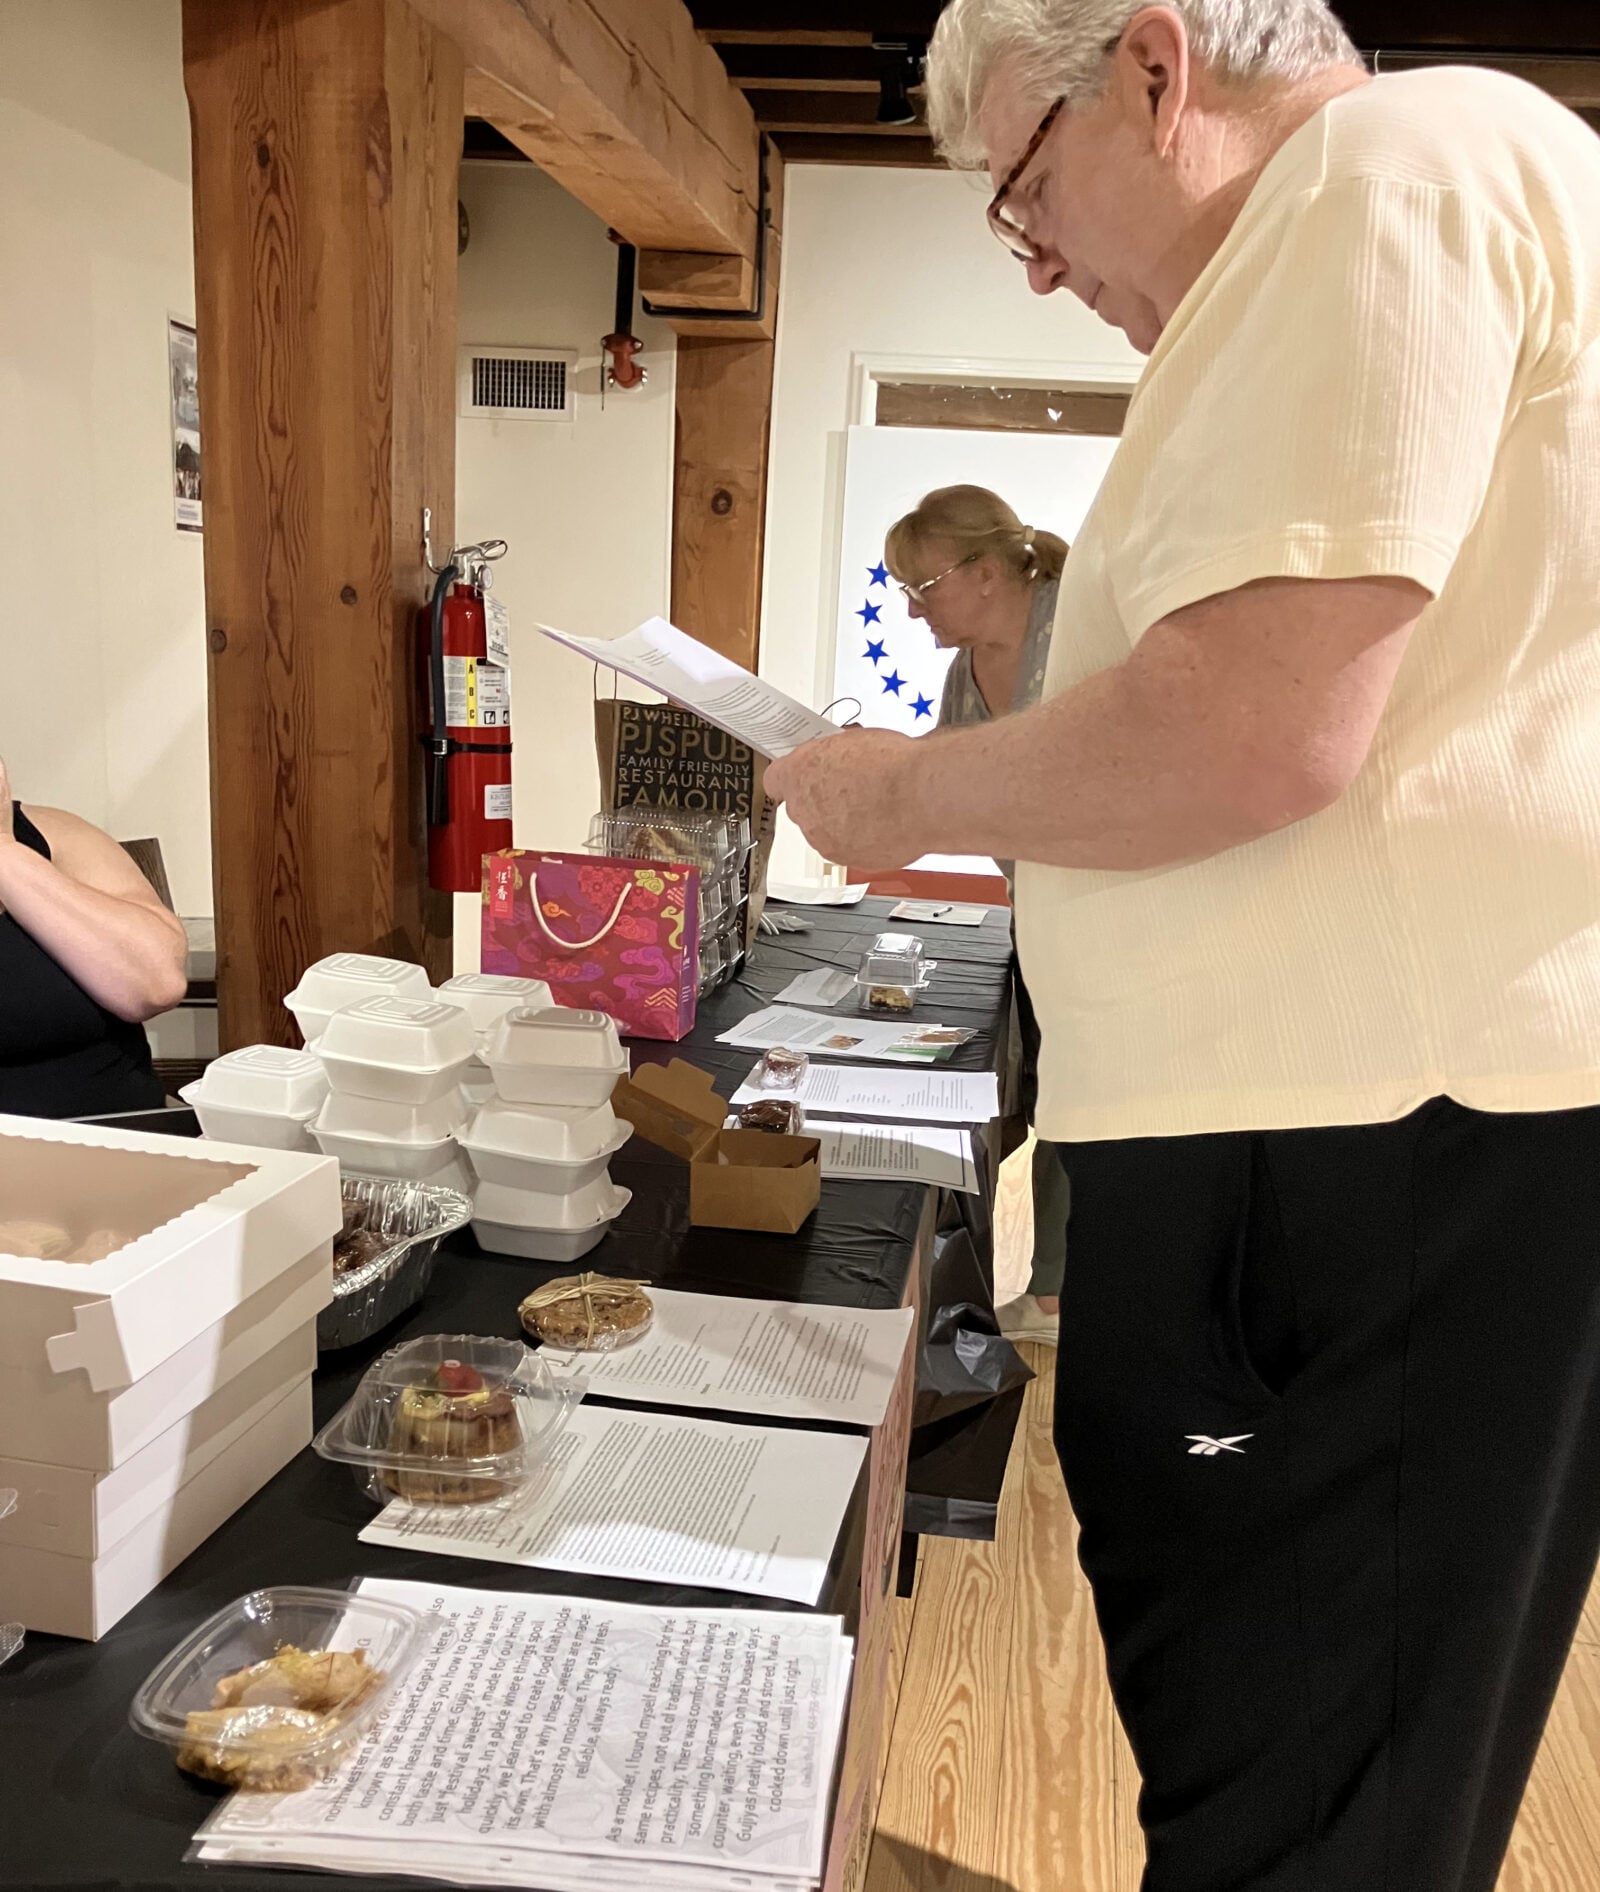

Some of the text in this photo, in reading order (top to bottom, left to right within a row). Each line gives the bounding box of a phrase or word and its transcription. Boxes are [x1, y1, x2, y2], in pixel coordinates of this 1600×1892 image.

[468, 664, 474, 674] A
[470, 709, 475, 719] C
[618, 767, 750, 791] RESTAURANT
[619, 754, 750, 777] FAMILY FRIENDLY
[616, 783, 750, 815] FAMOUS
[503, 1610, 527, 1638] Hindu
[573, 1613, 591, 1640] made
[661, 1618, 676, 1633] the
[679, 1619, 698, 1635] but
[470, 1631, 496, 1660] halwa
[499, 1640, 514, 1656] our
[567, 1640, 582, 1656] are
[654, 1633, 672, 1648] for
[696, 1622, 722, 1663] knowing
[466, 1661, 483, 1680] and
[488, 1657, 508, 1671] for
[555, 1657, 576, 1692] sweets
[648, 1648, 672, 1692] reaching
[694, 1664, 709, 1674] in
[736, 1650, 756, 1686] busiest
[448, 1681, 475, 1714] Gujiya
[480, 1672, 502, 1701] made
[664, 1666, 687, 1711] tradition
[688, 1675, 707, 1716] comfort
[733, 1686, 750, 1704] the
[779, 1684, 797, 1705] just
[324, 1746, 373, 1822] northwestern
[426, 1596, 445, 1616] lso
[377, 1605, 484, 1820] constant heat teaches you how to cook for
[392, 1693, 423, 1733] dessert
[455, 1620, 545, 1814] holidays. In a place where things spoil
[477, 1606, 572, 1834] quickly, we learned to create food that holds
[542, 1694, 564, 1722] these
[574, 1663, 622, 1779] reliable, always ready.
[638, 1693, 657, 1729] myself
[659, 1712, 676, 1723] of
[734, 1705, 747, 1719] on
[777, 1706, 793, 1731] until
[436, 1715, 460, 1744] time.
[531, 1619, 613, 1829] with almost no moisture. They stay fresh,
[535, 1724, 557, 1747] why
[658, 1724, 673, 1743] out
[684, 1717, 698, 1738] was
[685, 1630, 738, 1836] something homemade would sit on the
[729, 1721, 744, 1747] even
[734, 1633, 781, 1842] Gujiyas neatly folded and stored, halwa
[382, 1734, 404, 1753] the
[429, 1745, 448, 1768] and
[624, 1730, 648, 1763] found
[653, 1744, 668, 1763] not
[672, 1739, 693, 1772] There
[771, 1732, 789, 1765] down
[378, 1756, 394, 1769] as
[519, 1748, 545, 1784] That's
[720, 1749, 743, 1795] waiting,
[353, 1770, 386, 1809] known
[413, 1770, 438, 1798] taste
[614, 1770, 640, 1816] mother,
[641, 1765, 666, 1810] recipes,
[767, 1766, 786, 1812] cooked
[396, 1800, 423, 1826] both
[425, 1801, 449, 1823] just
[502, 1815, 522, 1829] its
[711, 1797, 734, 1849] counter,
[603, 1826, 623, 1843] As
[632, 1811, 652, 1844] same
